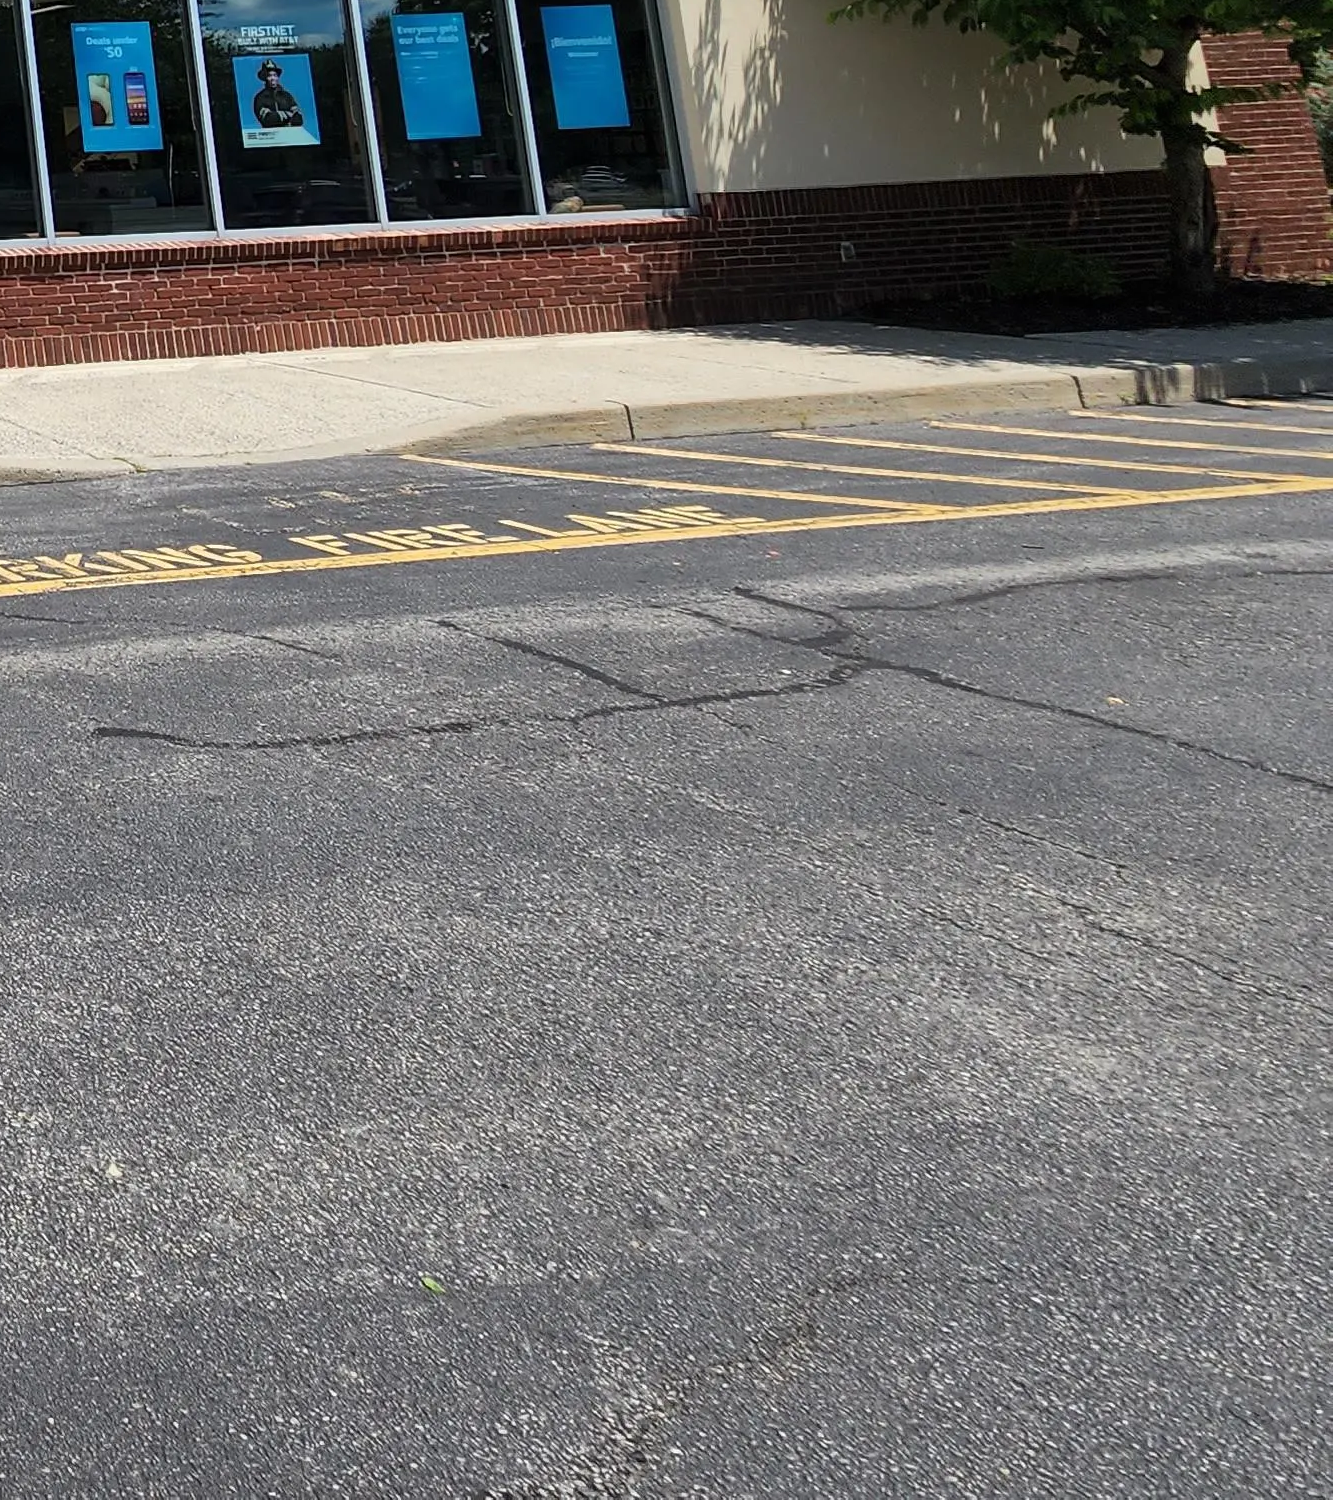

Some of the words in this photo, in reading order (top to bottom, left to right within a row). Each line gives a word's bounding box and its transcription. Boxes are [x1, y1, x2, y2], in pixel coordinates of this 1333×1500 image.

[240, 24, 296, 37] FIRSTNET
[289, 523, 520, 555] FIRE
[498, 504, 767, 537] LANE
